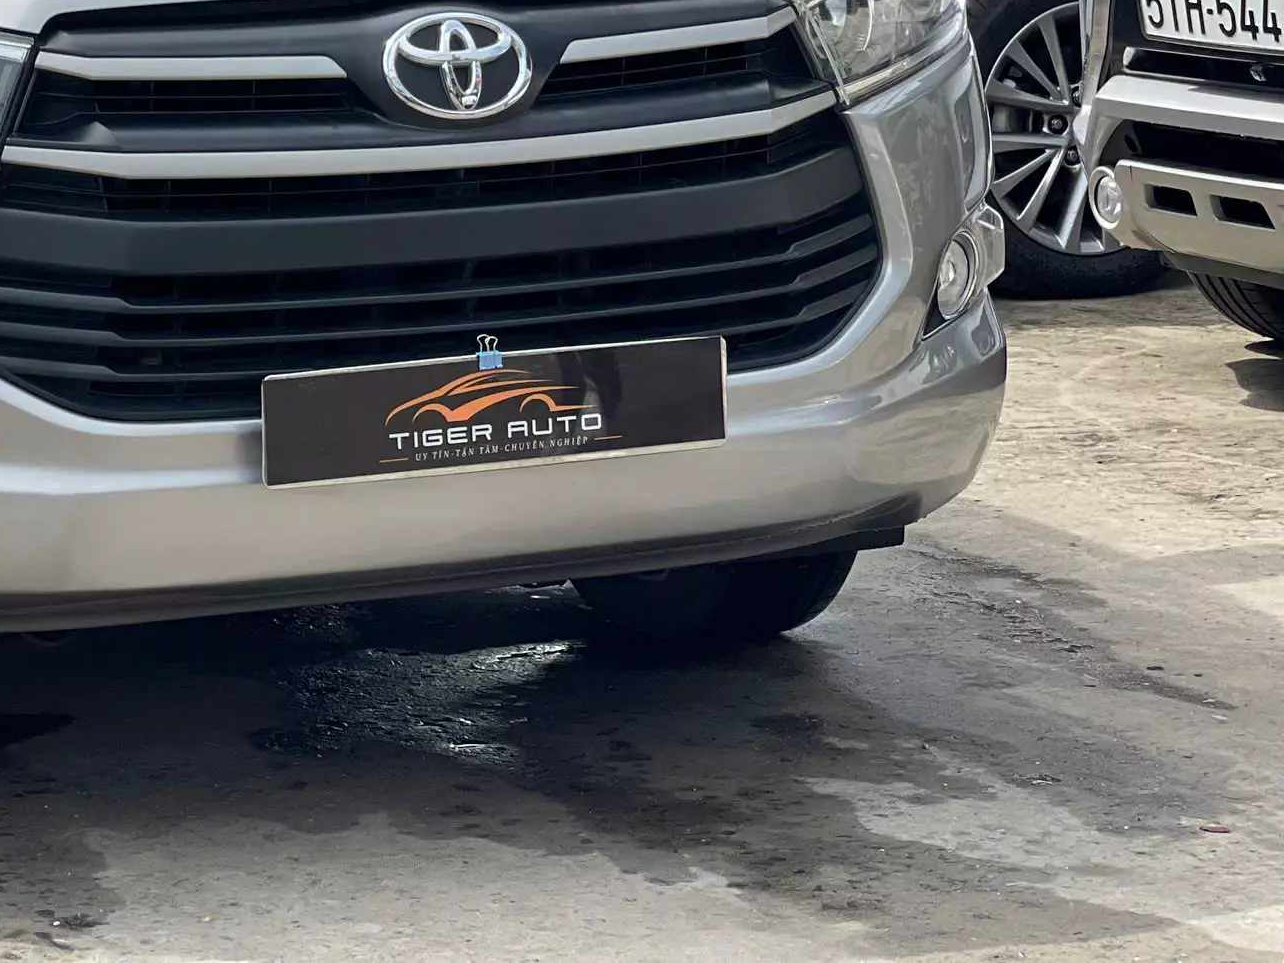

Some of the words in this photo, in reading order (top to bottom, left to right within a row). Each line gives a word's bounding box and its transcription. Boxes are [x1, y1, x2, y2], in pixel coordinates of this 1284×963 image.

[388, 423, 492, 450] TIGER
[507, 413, 602, 438] AUTO
[415, 452, 428, 462] UY
